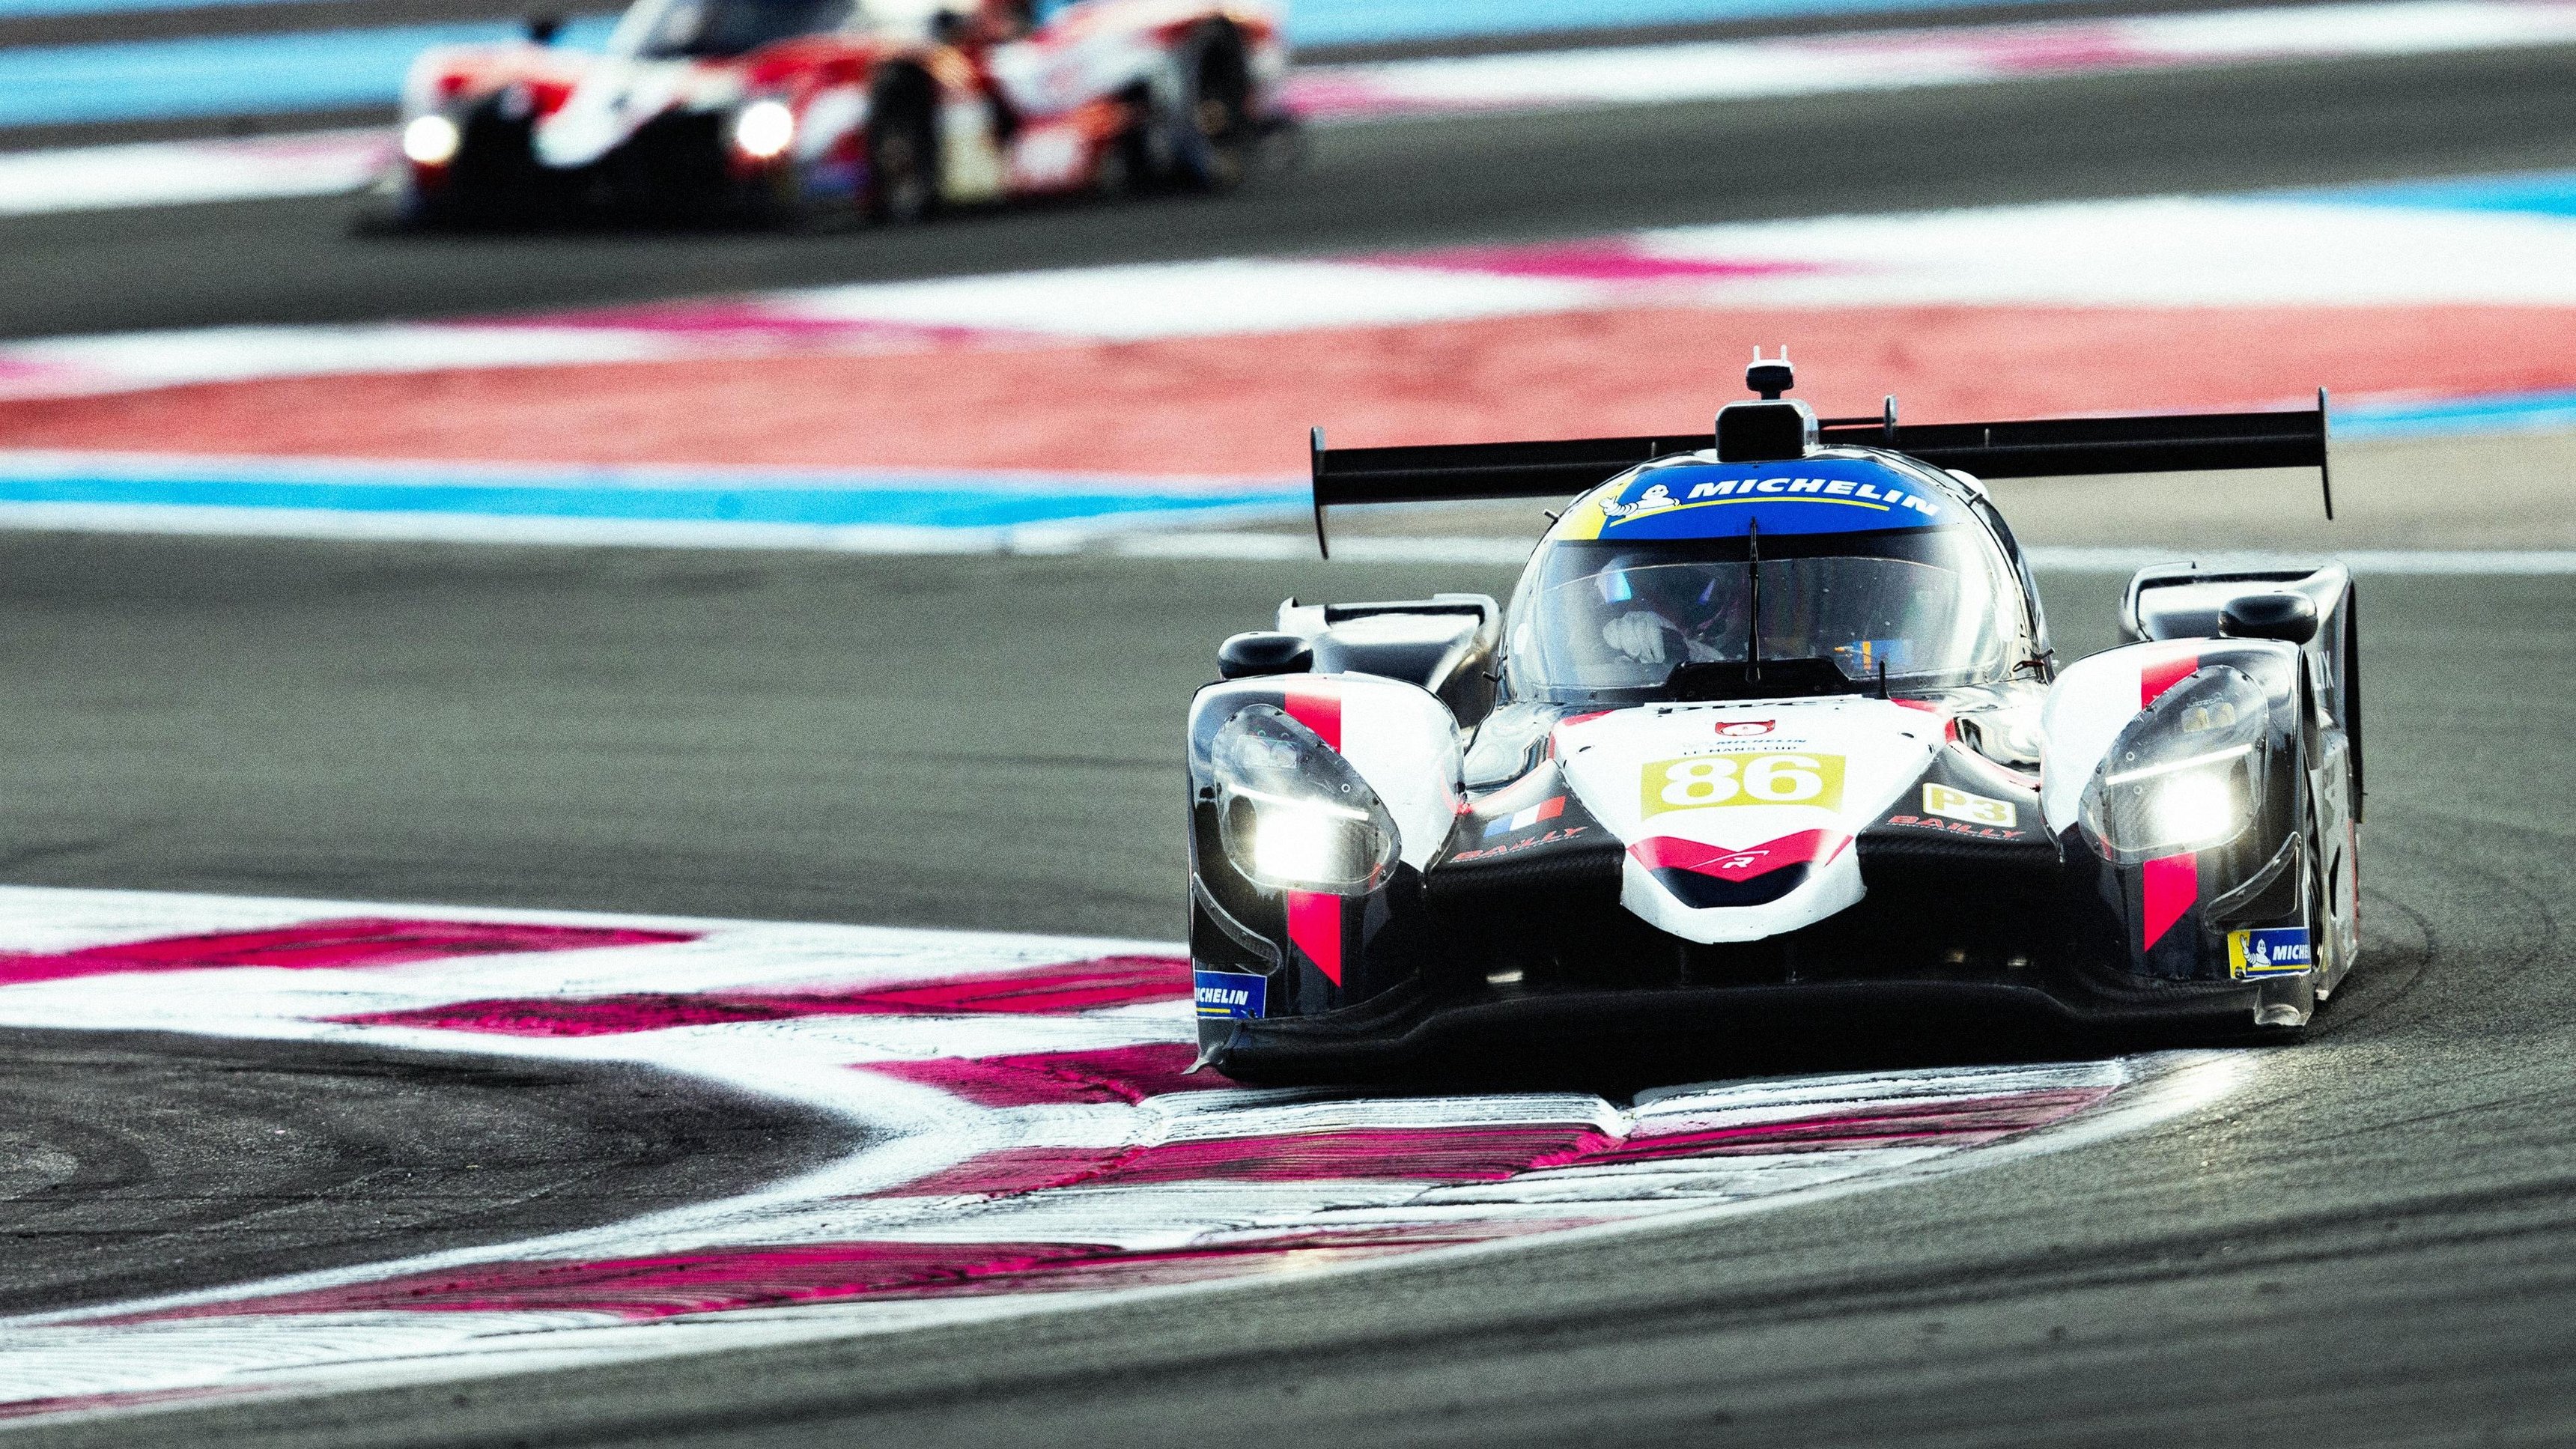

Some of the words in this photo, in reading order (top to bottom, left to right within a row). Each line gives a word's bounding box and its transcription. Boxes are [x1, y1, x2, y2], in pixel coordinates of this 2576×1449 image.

[1687, 478, 1941, 516] MICHELIN
[1661, 755, 1823, 806] 86
[1931, 787, 2008, 822] P3
[1450, 826, 1589, 861] BAILLY
[1887, 815, 2027, 839] BAILLY
[2273, 944, 2310, 961] MICHE
[1195, 987, 1249, 1006] ICHELIN
